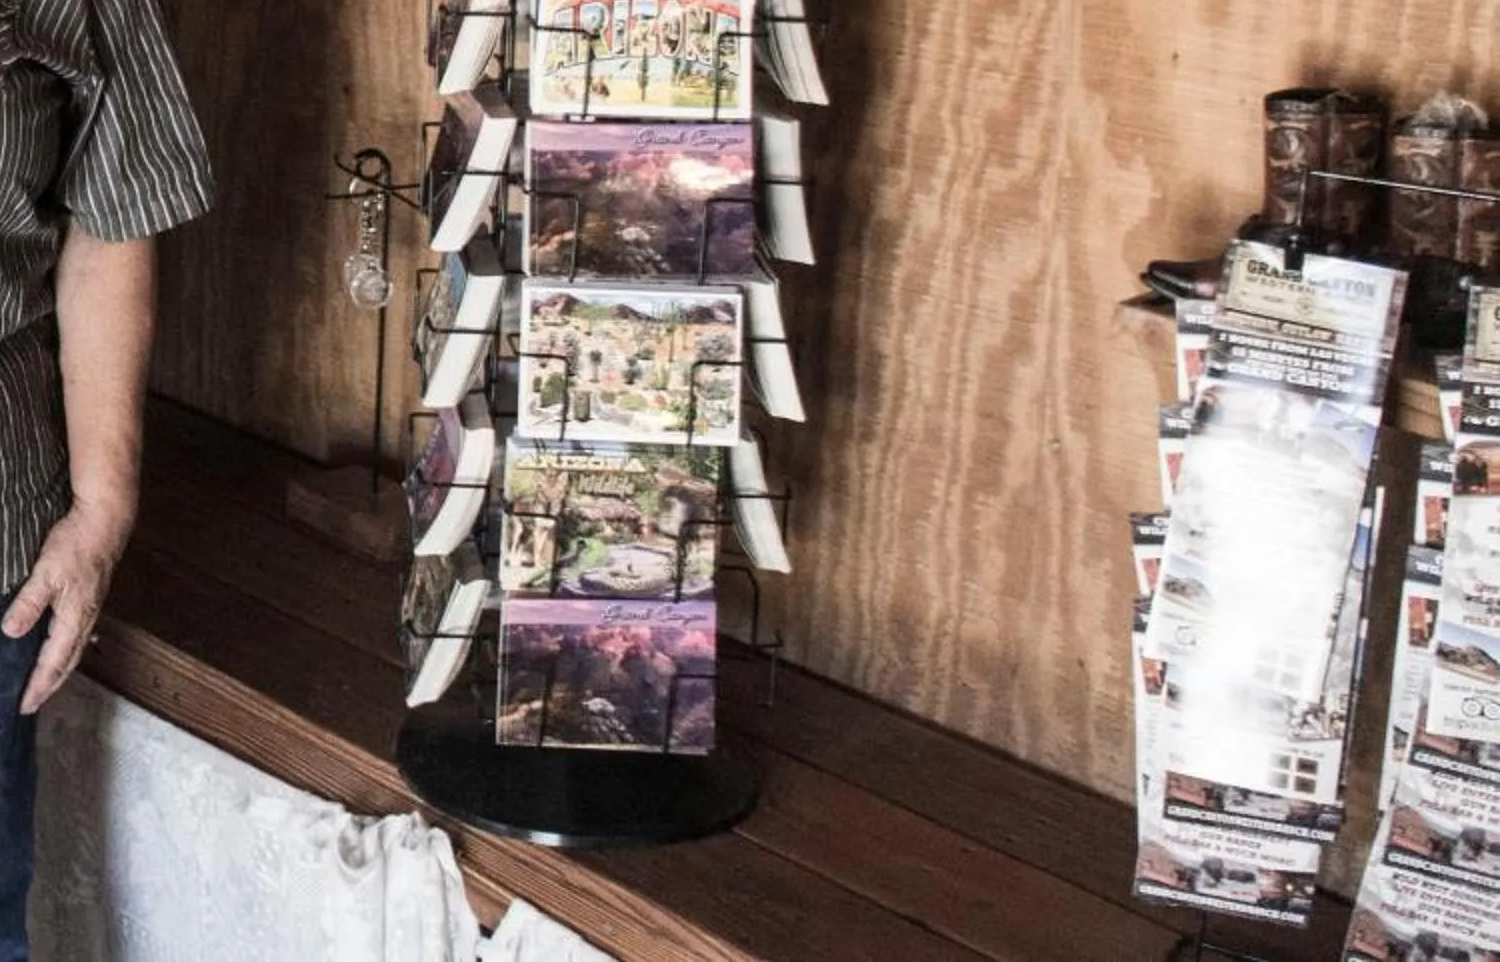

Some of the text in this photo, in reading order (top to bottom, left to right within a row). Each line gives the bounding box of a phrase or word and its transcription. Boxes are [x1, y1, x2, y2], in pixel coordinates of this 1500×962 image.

[636, 128, 745, 149] Grand Canyon
[603, 605, 709, 624] Grand Canyon
